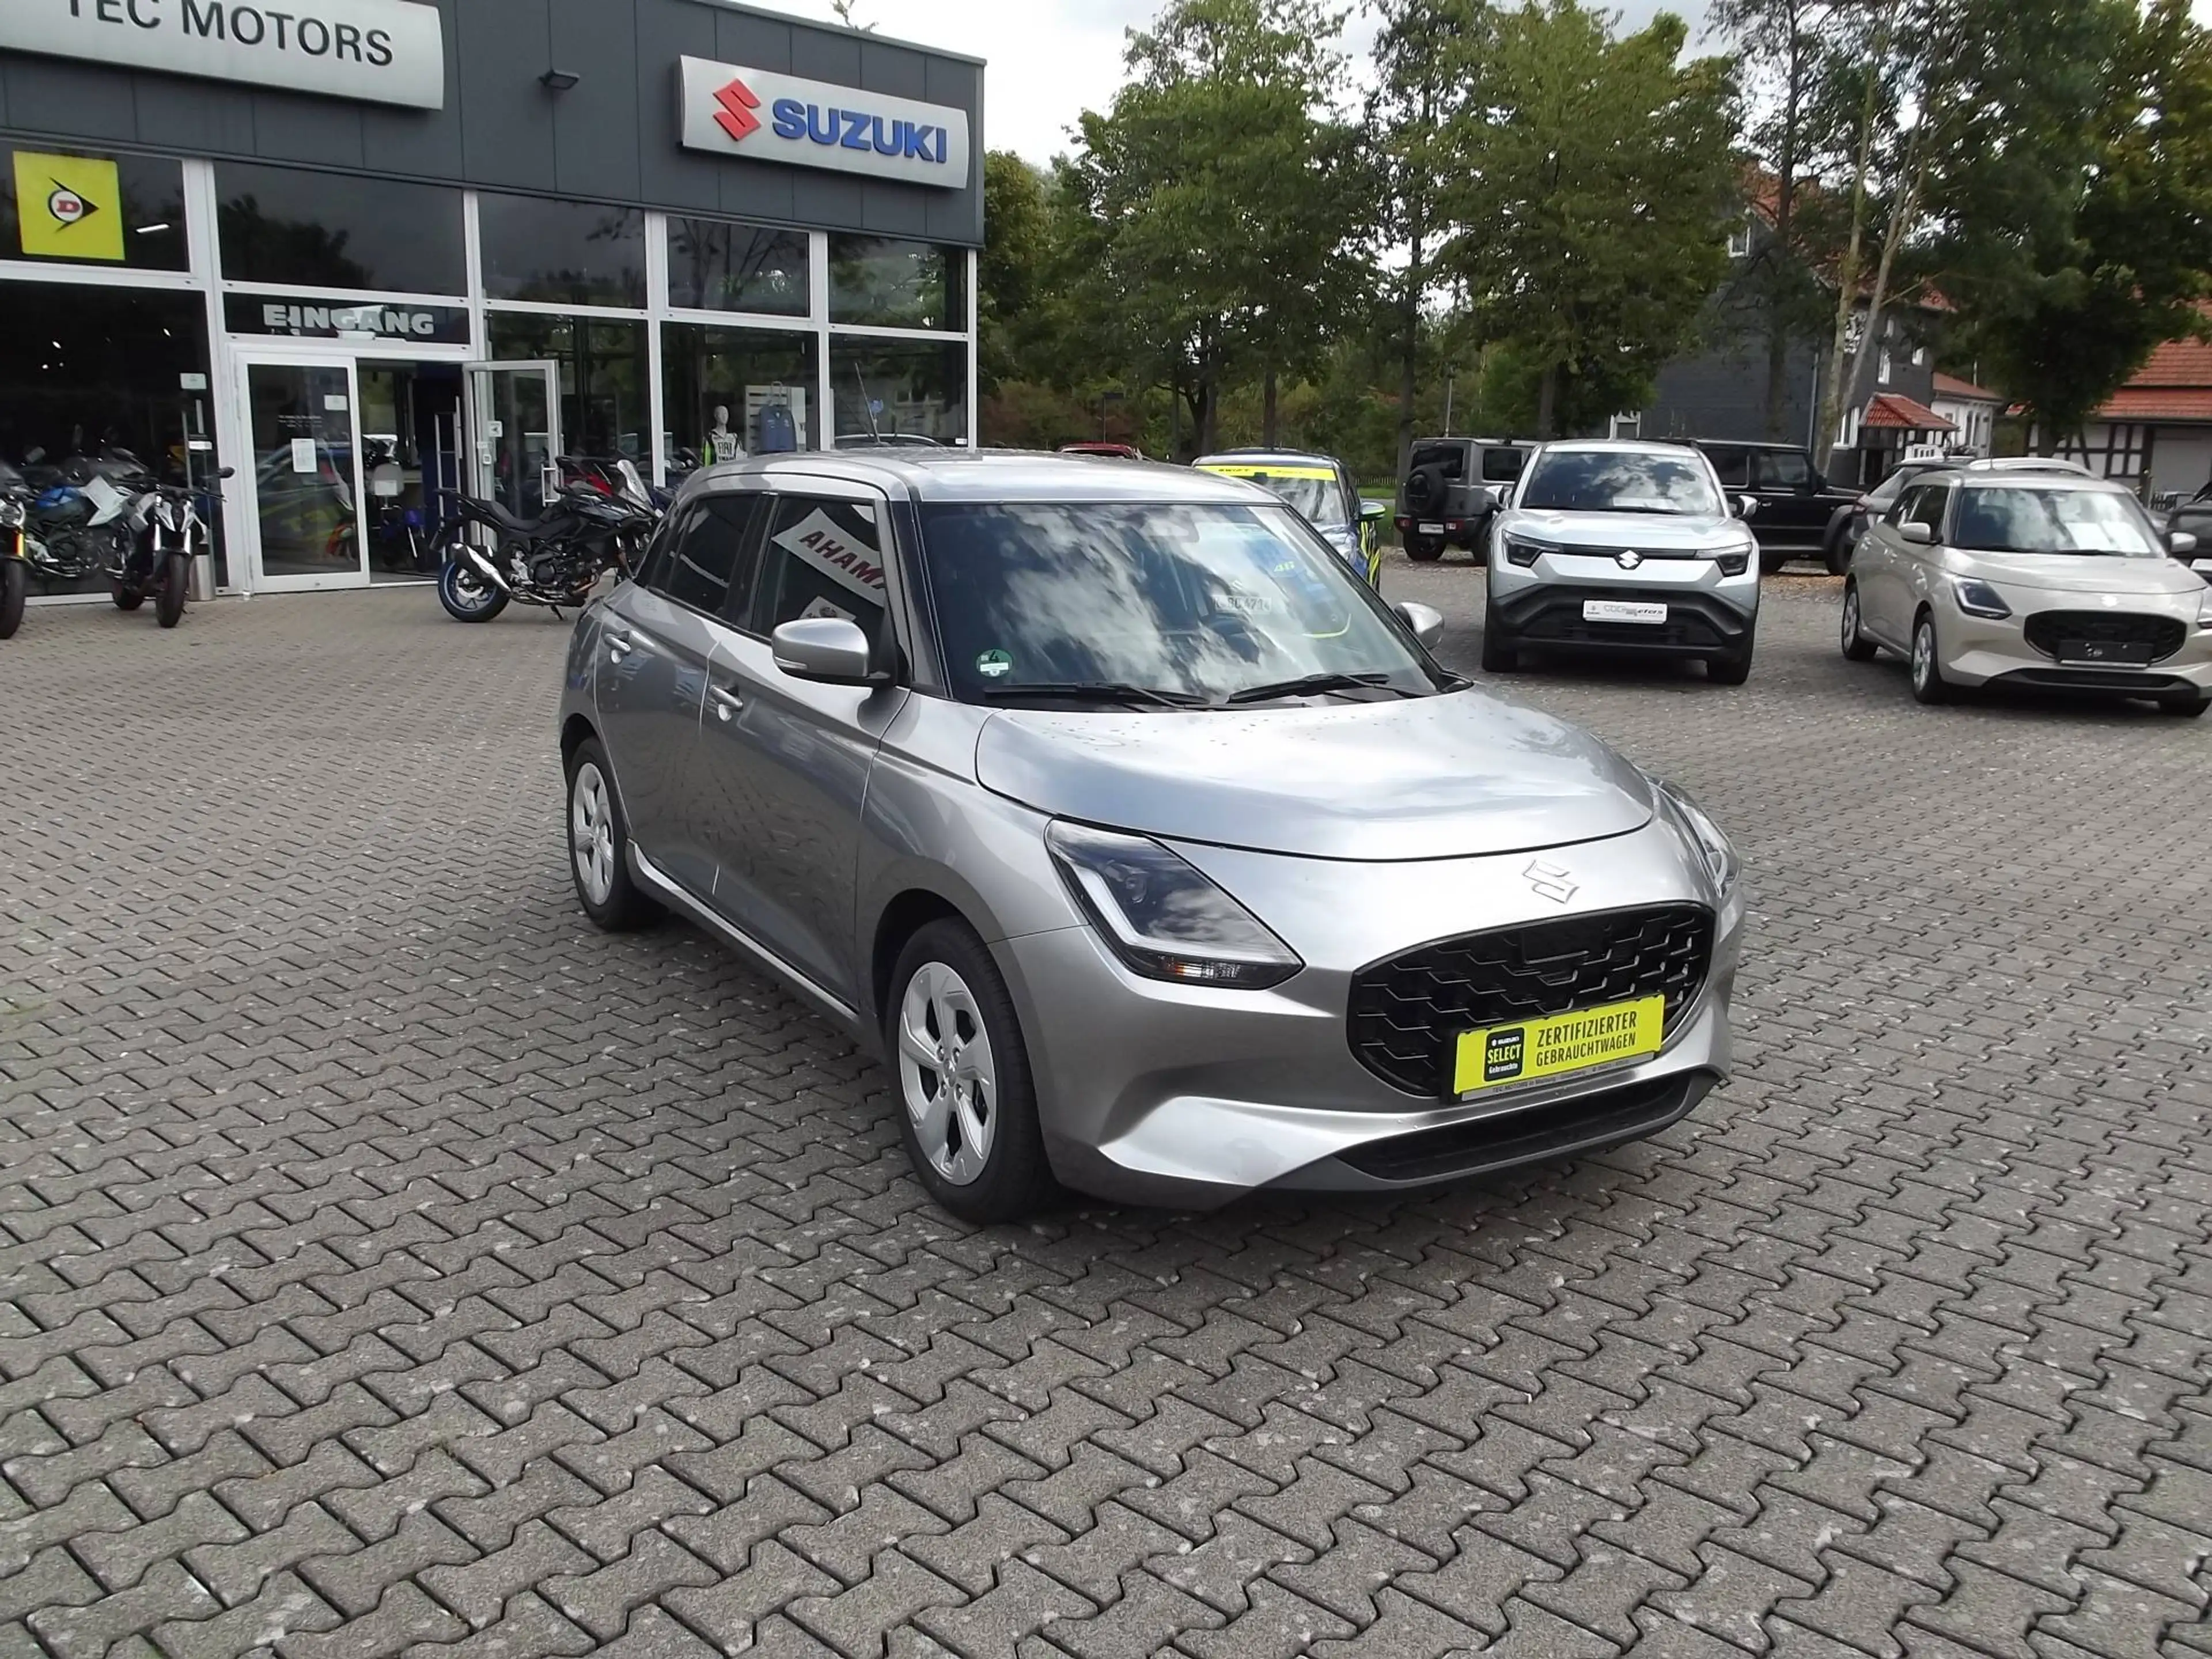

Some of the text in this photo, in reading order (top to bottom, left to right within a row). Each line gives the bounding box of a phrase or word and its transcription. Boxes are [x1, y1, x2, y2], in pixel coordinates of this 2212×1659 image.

[181, 0, 393, 66] MOTORS
[772, 99, 947, 164] SUZUKI
[263, 304, 434, 334] EINGANG
[1537, 1011, 1637, 1048] ZERTIFIZIERTER
[1487, 1043, 1521, 1064] SELECT
[1536, 1032, 1636, 1067] GEBRAUCHTWAGEN
